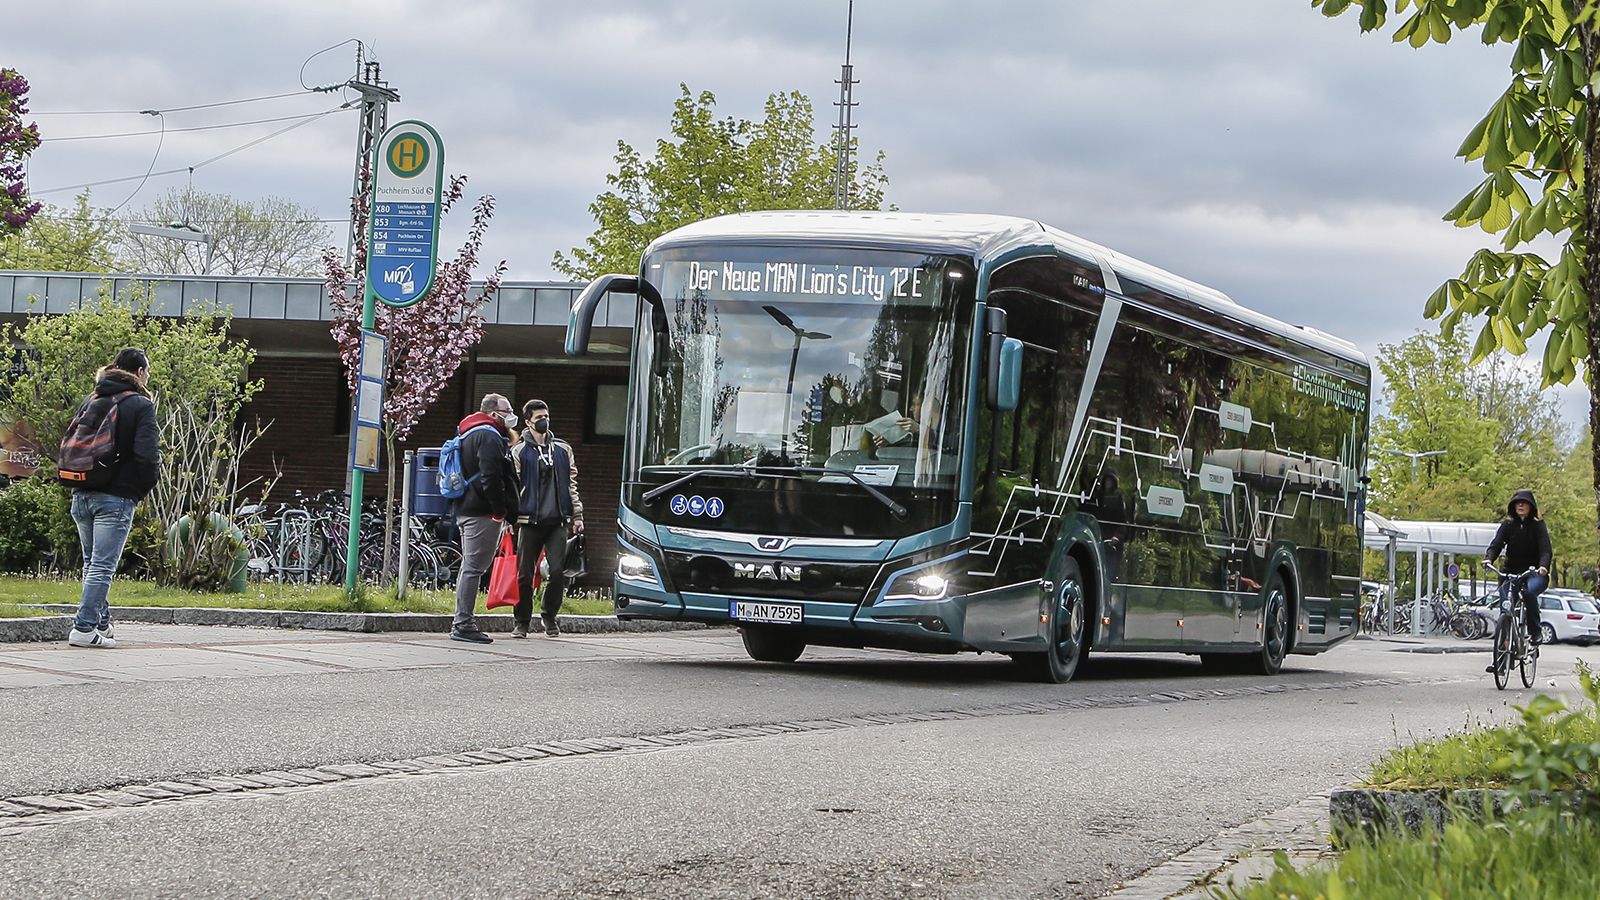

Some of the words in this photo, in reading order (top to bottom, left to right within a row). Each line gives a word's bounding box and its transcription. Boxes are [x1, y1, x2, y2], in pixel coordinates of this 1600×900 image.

[399, 143, 417, 167] H
[377, 187, 410, 195] Puchheim
[411, 187, 424, 195] Süd
[375, 205, 391, 213] X80
[374, 218, 389, 227] 853
[373, 231, 388, 240] 854
[384, 265, 411, 283] MVV
[688, 261, 719, 291] Der
[721, 261, 761, 292] Neue
[764, 262, 798, 293] MAN
[800, 263, 848, 295] Lion's
[851, 265, 885, 301] City
[889, 266, 909, 297] 12
[911, 267, 924, 298] E
[1292, 364, 1367, 416] #ElectrifyingEurope
[734, 562, 802, 582] MAN
[737, 603, 746, 617] M
[753, 604, 769, 618] AN
[771, 606, 801, 620] 7595
